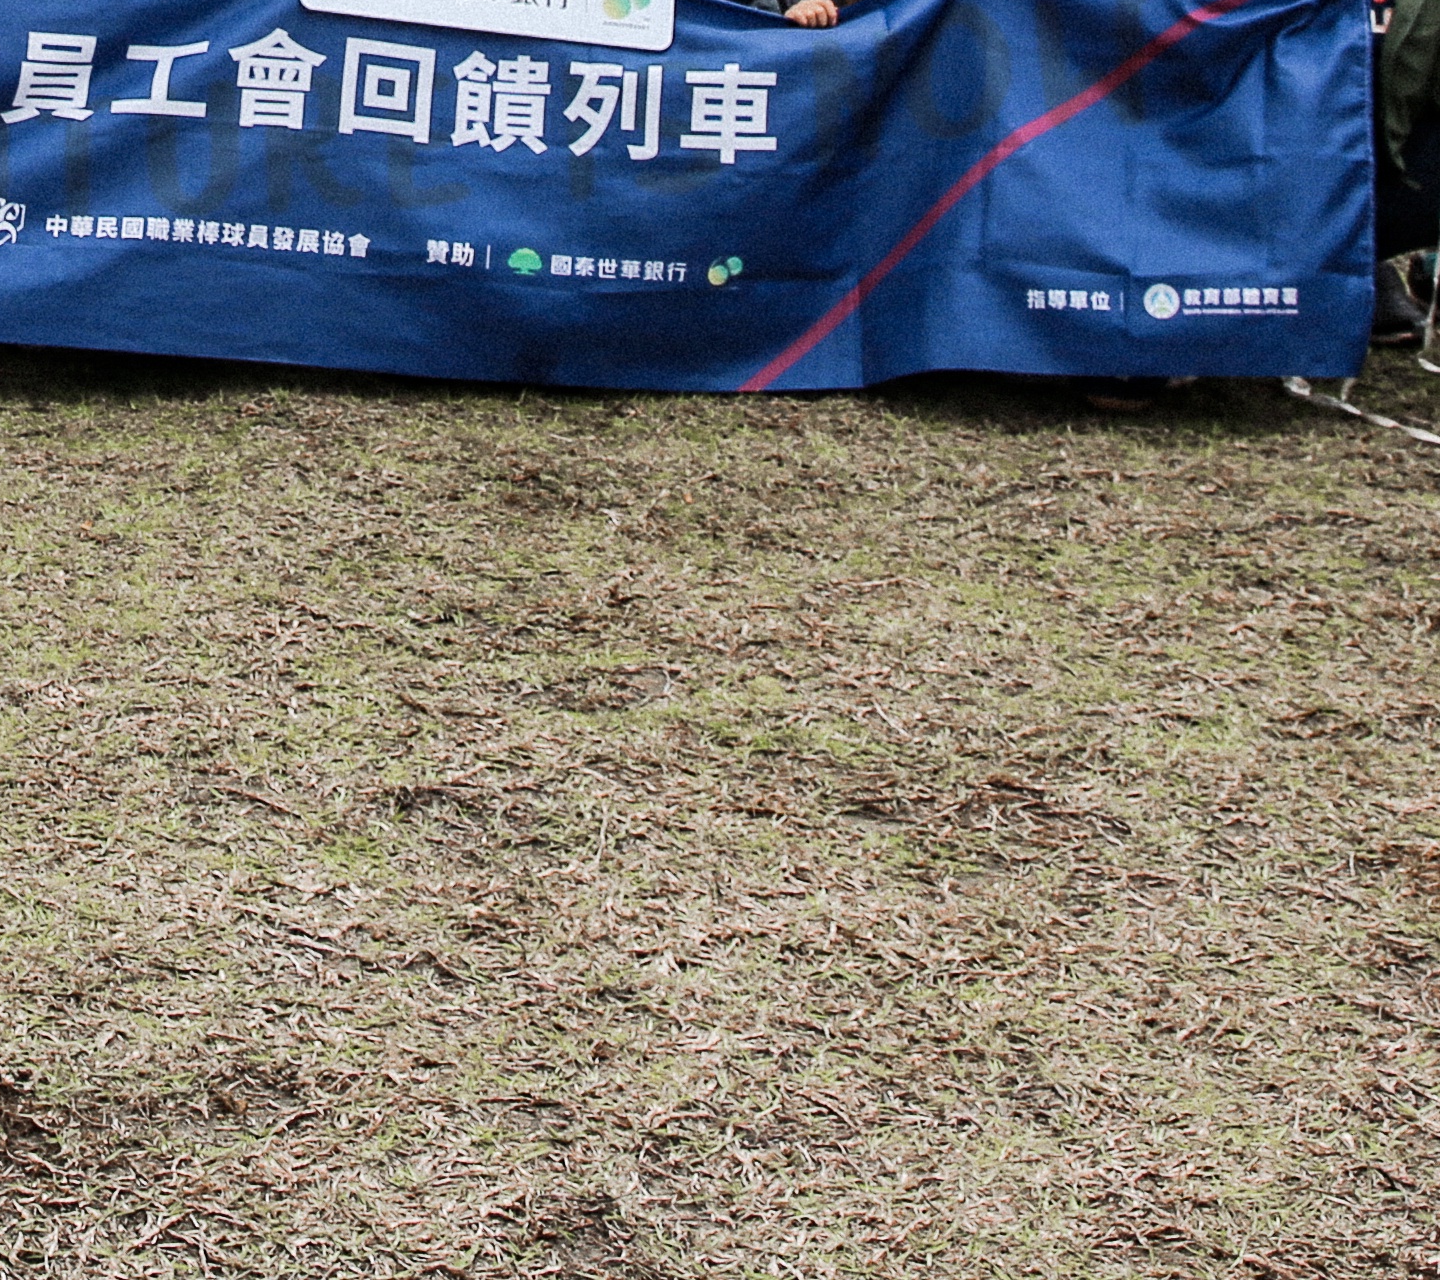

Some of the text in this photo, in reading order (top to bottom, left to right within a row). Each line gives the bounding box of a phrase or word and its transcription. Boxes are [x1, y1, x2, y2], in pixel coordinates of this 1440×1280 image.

[45, 215, 371, 258] 中華民國職業棒球員發展協會
[550, 254, 687, 282] 國泰世華銀行
[1026, 289, 1110, 311] 指導單位
